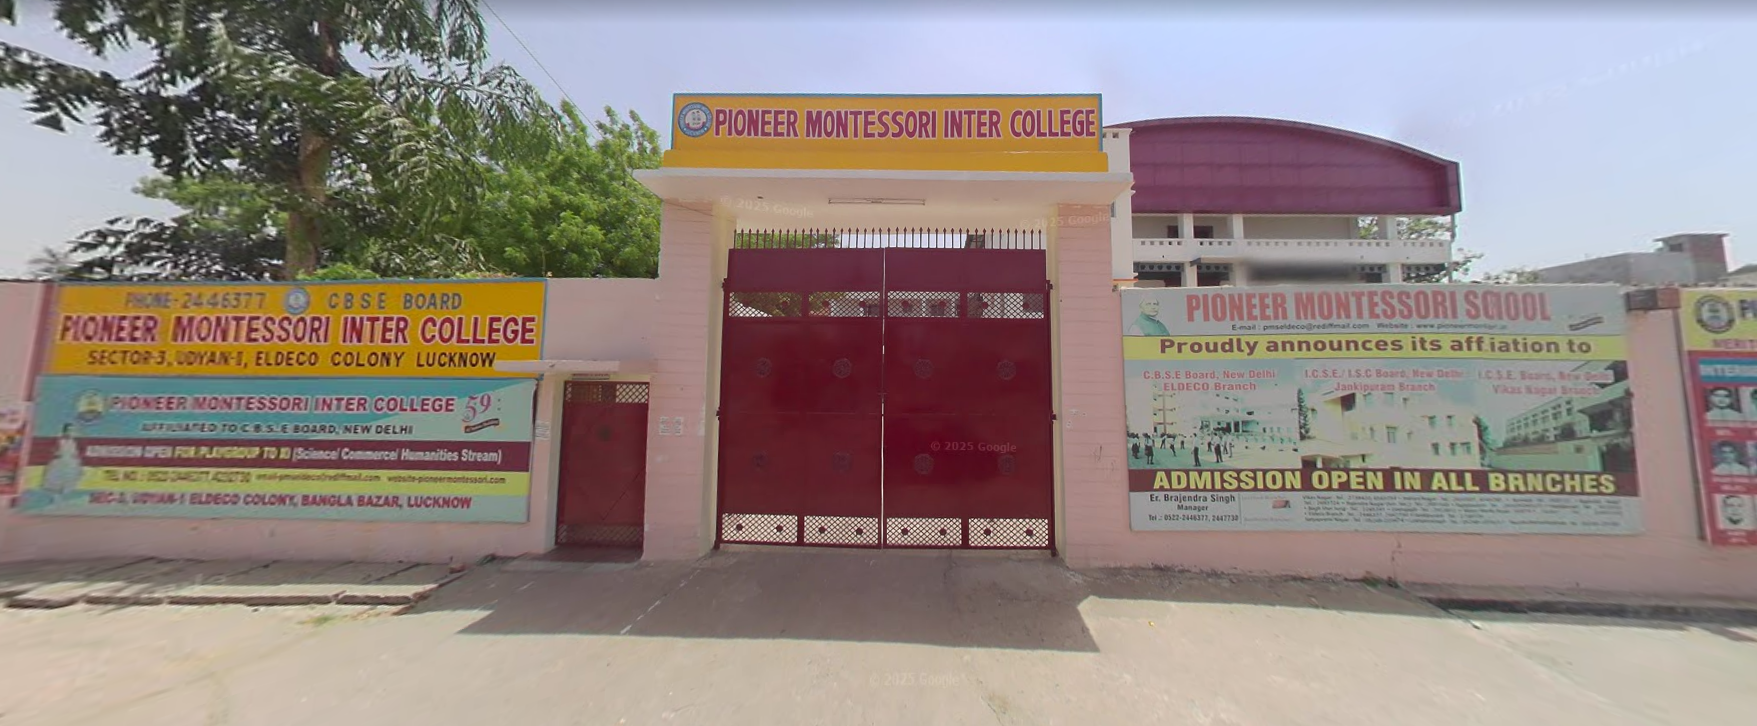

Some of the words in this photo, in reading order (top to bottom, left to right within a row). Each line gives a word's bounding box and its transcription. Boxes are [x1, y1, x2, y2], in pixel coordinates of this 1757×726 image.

[714, 109, 799, 138] PIONEER
[805, 109, 937, 138] MONTESSORI
[944, 109, 1002, 138] INTER
[1010, 109, 1097, 138] COLLEGE
[403, 293, 462, 310] BOARD
[1186, 292, 1288, 322] PIONEER
[1294, 290, 1459, 321] MONTESSORI
[60, 314, 159, 343] PIONEER
[171, 315, 330, 344] MONTESSORI
[342, 316, 410, 345] INTER
[420, 316, 536, 345] COLLEGE
[1231, 323, 1256, 331] E-mail
[1377, 322, 1409, 330] Website
[1160, 338, 1259, 356] Proudly
[1265, 337, 1404, 353] announces
[1411, 336, 1442, 351] its
[1566, 338, 1592, 353] to
[255, 351, 319, 367] ELDECO
[330, 352, 404, 367] COLONY
[416, 352, 496, 368] LUCKNOW
[1143, 371, 1181, 380] C.B.S.E
[1185, 370, 1219, 381] Board,
[1222, 370, 1246, 379] New
[1249, 370, 1275, 379] Delhi
[1412, 369, 1435, 378] New
[1163, 382, 1210, 391] ELDECO
[1214, 382, 1257, 391] Branch
[1334, 382, 1395, 392] Jankipuram
[1399, 382, 1436, 391] Branch
[1492, 384, 1522, 394] Vikas
[1524, 384, 1558, 396] Nagar
[111, 396, 187, 411] PIONEER
[198, 396, 309, 412] MONTESSORI
[314, 397, 367, 412] INTER
[373, 397, 456, 413] COLLEGE
[221, 424, 238, 433] TO
[343, 424, 371, 434] NEW
[375, 425, 414, 435] DELHI
[401, 448, 459, 462] Humanities
[461, 449, 502, 464] Stream)
[1153, 470, 1301, 490] ADMISSION
[1311, 470, 1385, 491] OPEN
[1394, 471, 1421, 491] IN
[1431, 471, 1480, 492] ALL
[189, 493, 241, 506] ELDECO
[301, 494, 354, 508] BANGLA
[357, 495, 402, 510] BAZAR,
[407, 496, 473, 510] LUCKNOW
[1149, 493, 1162, 503] Er.
[1164, 493, 1208, 504] Brajendra
[1210, 493, 1236, 504] Singh
[1177, 504, 1208, 512] Manager
